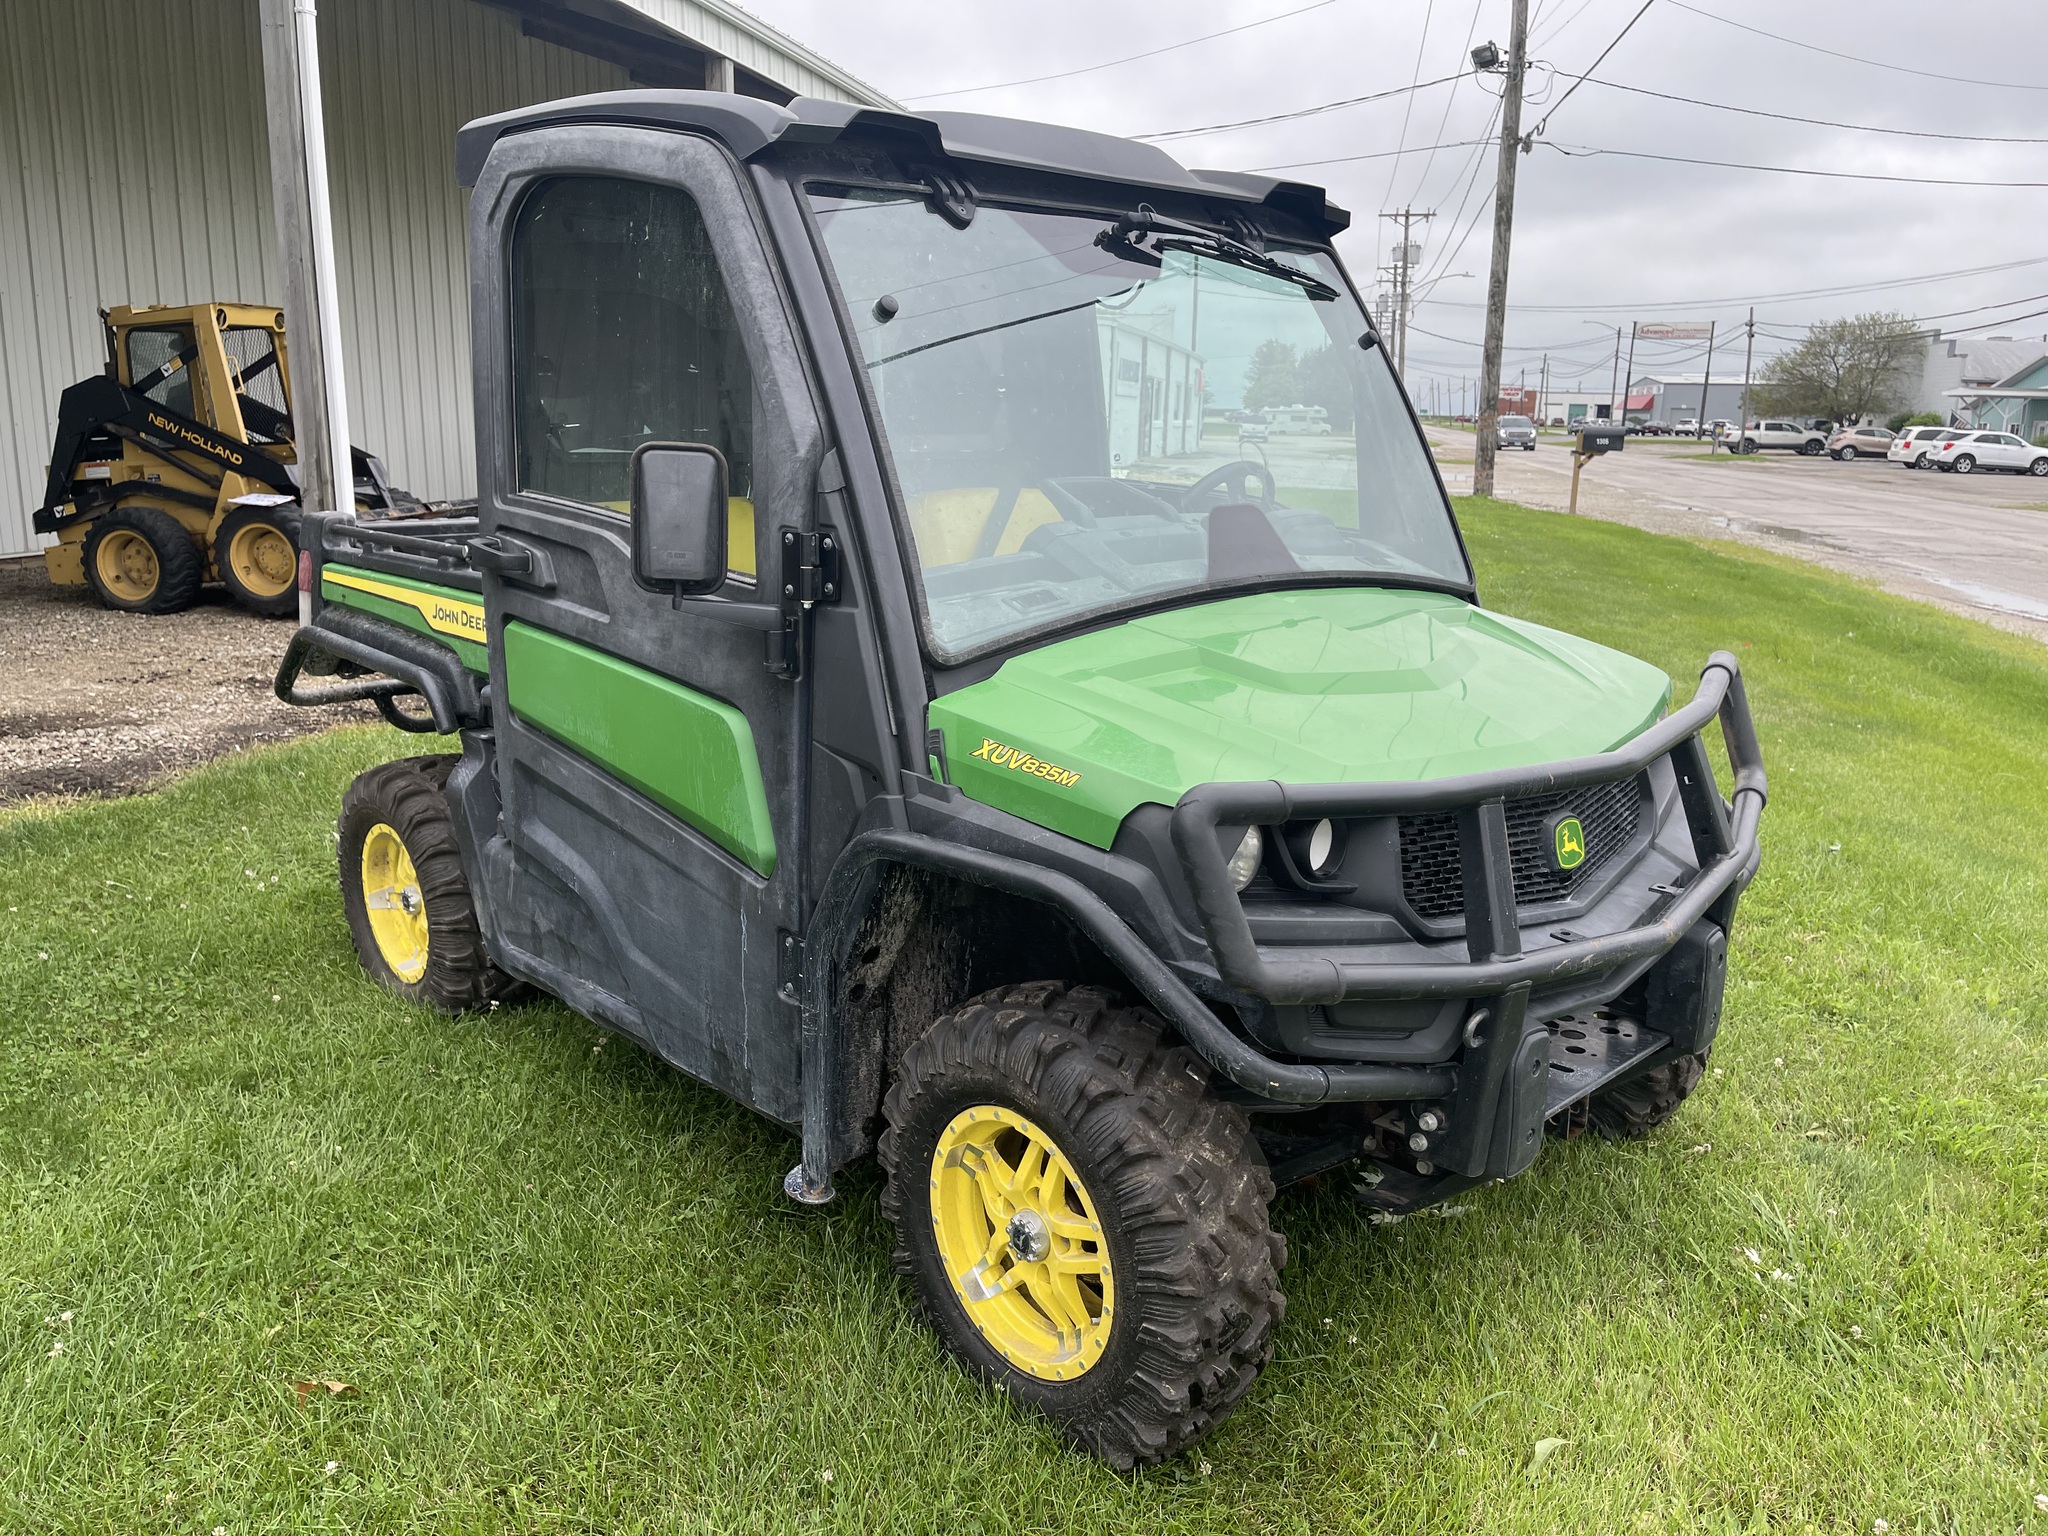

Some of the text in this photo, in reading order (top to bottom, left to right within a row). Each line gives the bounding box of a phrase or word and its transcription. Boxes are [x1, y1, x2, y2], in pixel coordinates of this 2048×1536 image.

[148, 412, 243, 465] NEW HOLLAND
[432, 603, 459, 625] JOHN
[969, 738, 1082, 788] XUV835M
